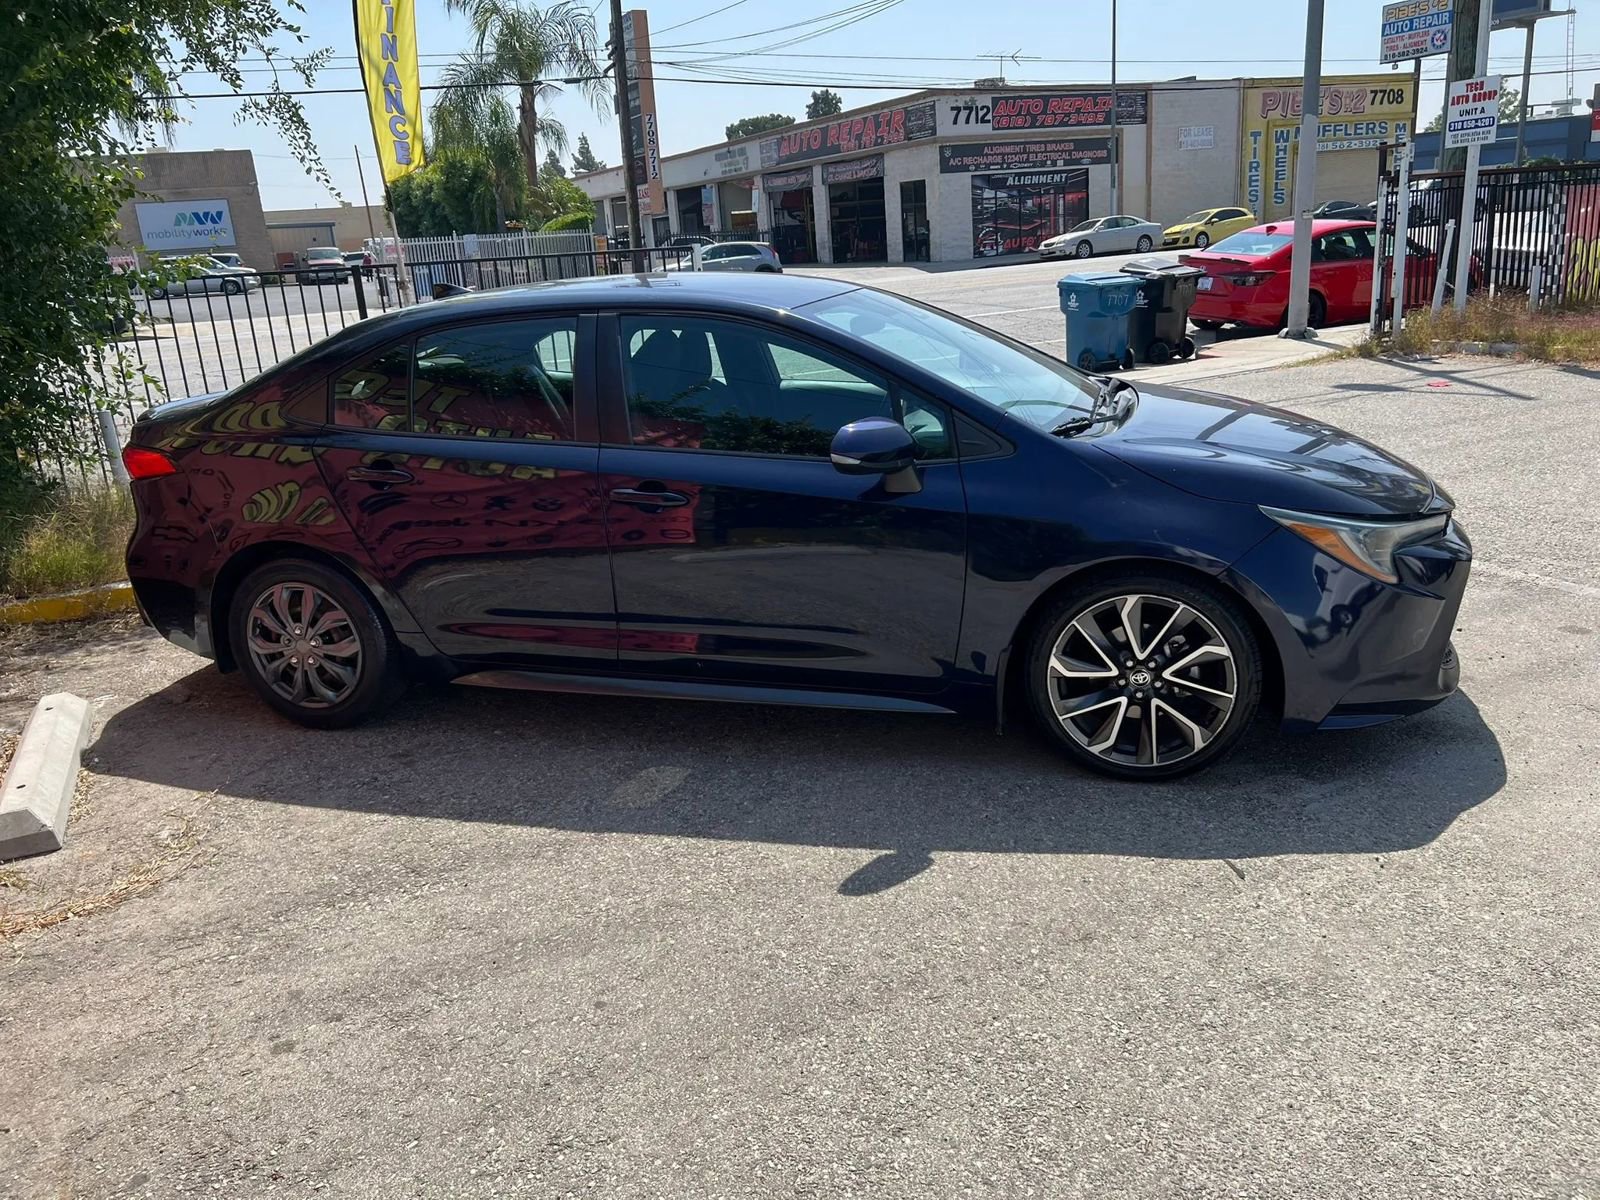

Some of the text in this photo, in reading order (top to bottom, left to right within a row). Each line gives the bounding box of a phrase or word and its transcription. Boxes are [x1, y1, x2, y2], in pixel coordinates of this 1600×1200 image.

[1384, 12, 1450, 36] AUTO REPAIR
[380, 0, 412, 165] INANCE
[1466, 81, 1485, 93] TECH
[1369, 88, 1405, 106] 7708
[1451, 90, 1498, 106] AUTO GROUP
[951, 105, 992, 126] 7712
[993, 98, 1044, 116] AUTO
[1459, 106, 1486, 117] UNIT A
[646, 113, 655, 145] 7708
[993, 116, 1032, 129] (818)
[779, 128, 823, 157] AUTO
[827, 109, 905, 146] REPAIR
[1179, 127, 1213, 138] FOR LEASE
[949, 149, 1108, 166] A/C RECHARGE 1234YF ELECTRICAL DIAGNOSIS
[984, 142, 1075, 155] ALIGNMENT TIRES BRAKES
[648, 148, 659, 180] 7712
[1248, 130, 1263, 204] TIRES
[1273, 129, 1291, 205] WHEELS
[1005, 173, 1068, 186] ALIGNMENT
